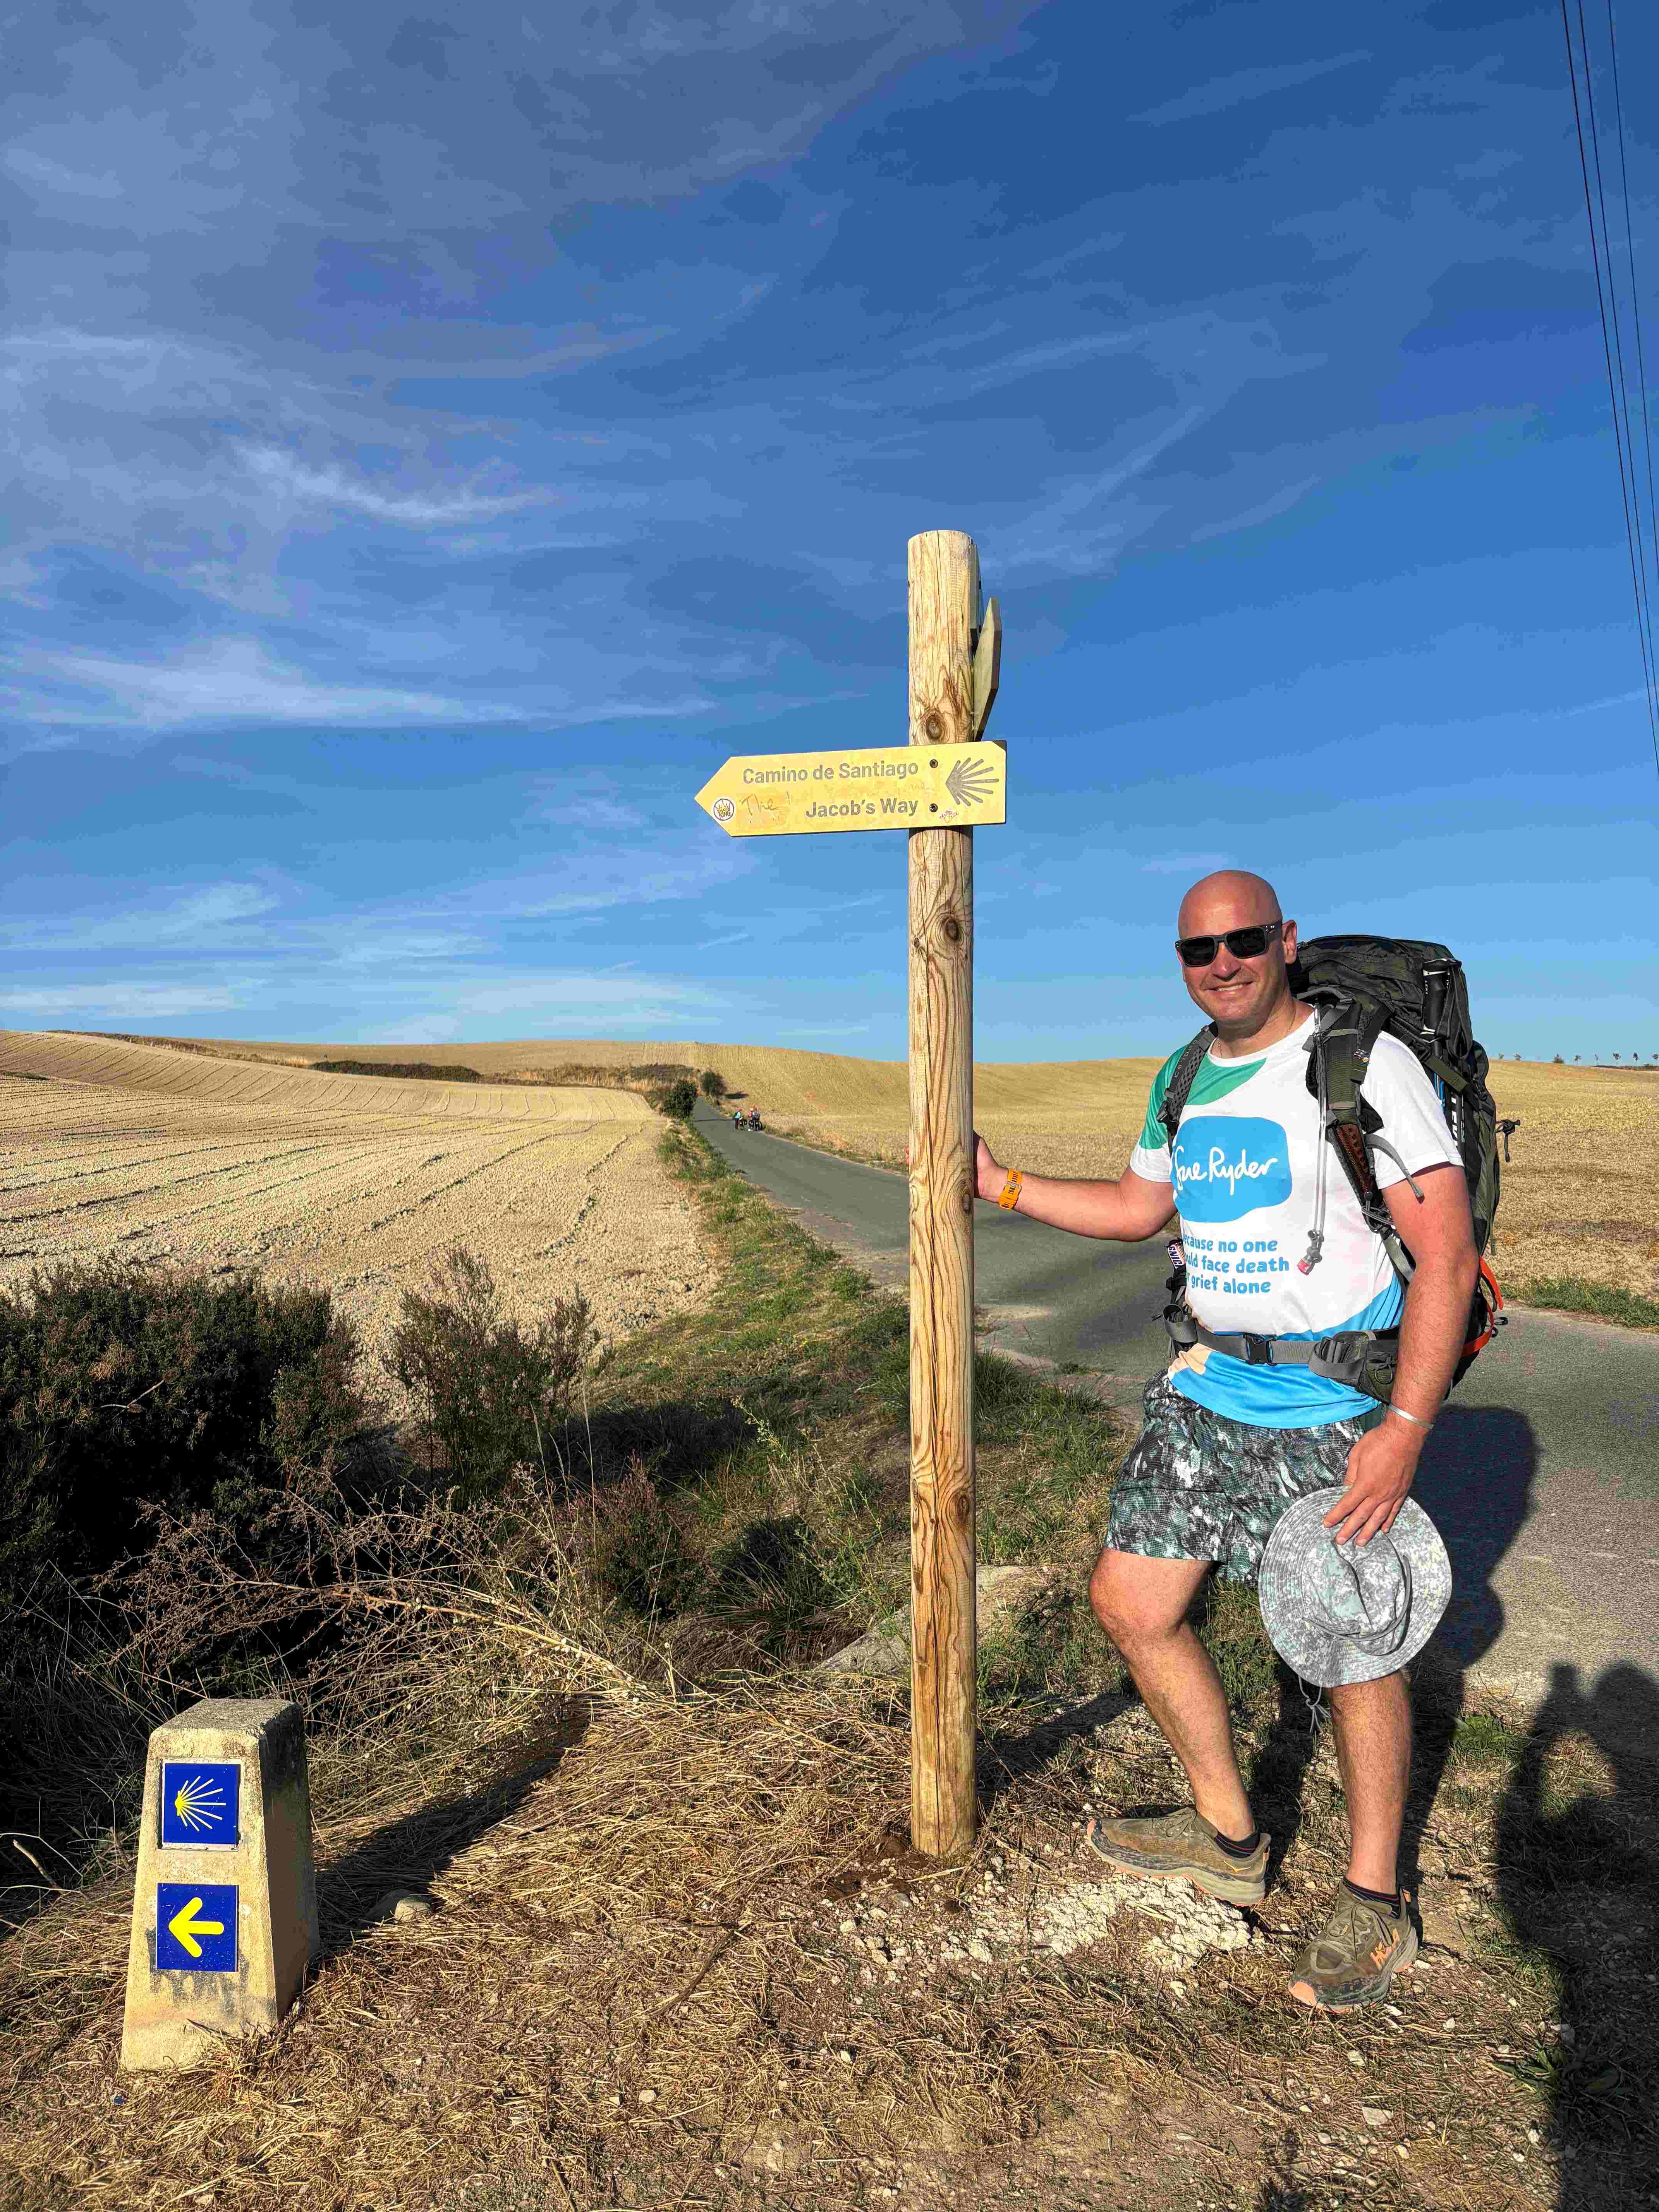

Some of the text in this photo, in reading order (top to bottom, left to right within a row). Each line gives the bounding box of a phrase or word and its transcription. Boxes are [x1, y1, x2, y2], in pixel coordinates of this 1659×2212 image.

[743, 760, 919, 784] Camino de Santiago
[805, 799, 876, 818] Jacob's
[879, 797, 919, 817] Way
[1174, 1145, 1278, 1196] Sue Ryder
[1218, 1240, 1238, 1253] no
[1243, 1240, 1278, 1253] one
[1202, 1255, 1230, 1273] face
[1235, 1256, 1290, 1274] death
[1191, 1274, 1218, 1291] grief
[1223, 1278, 1271, 1294] alone
